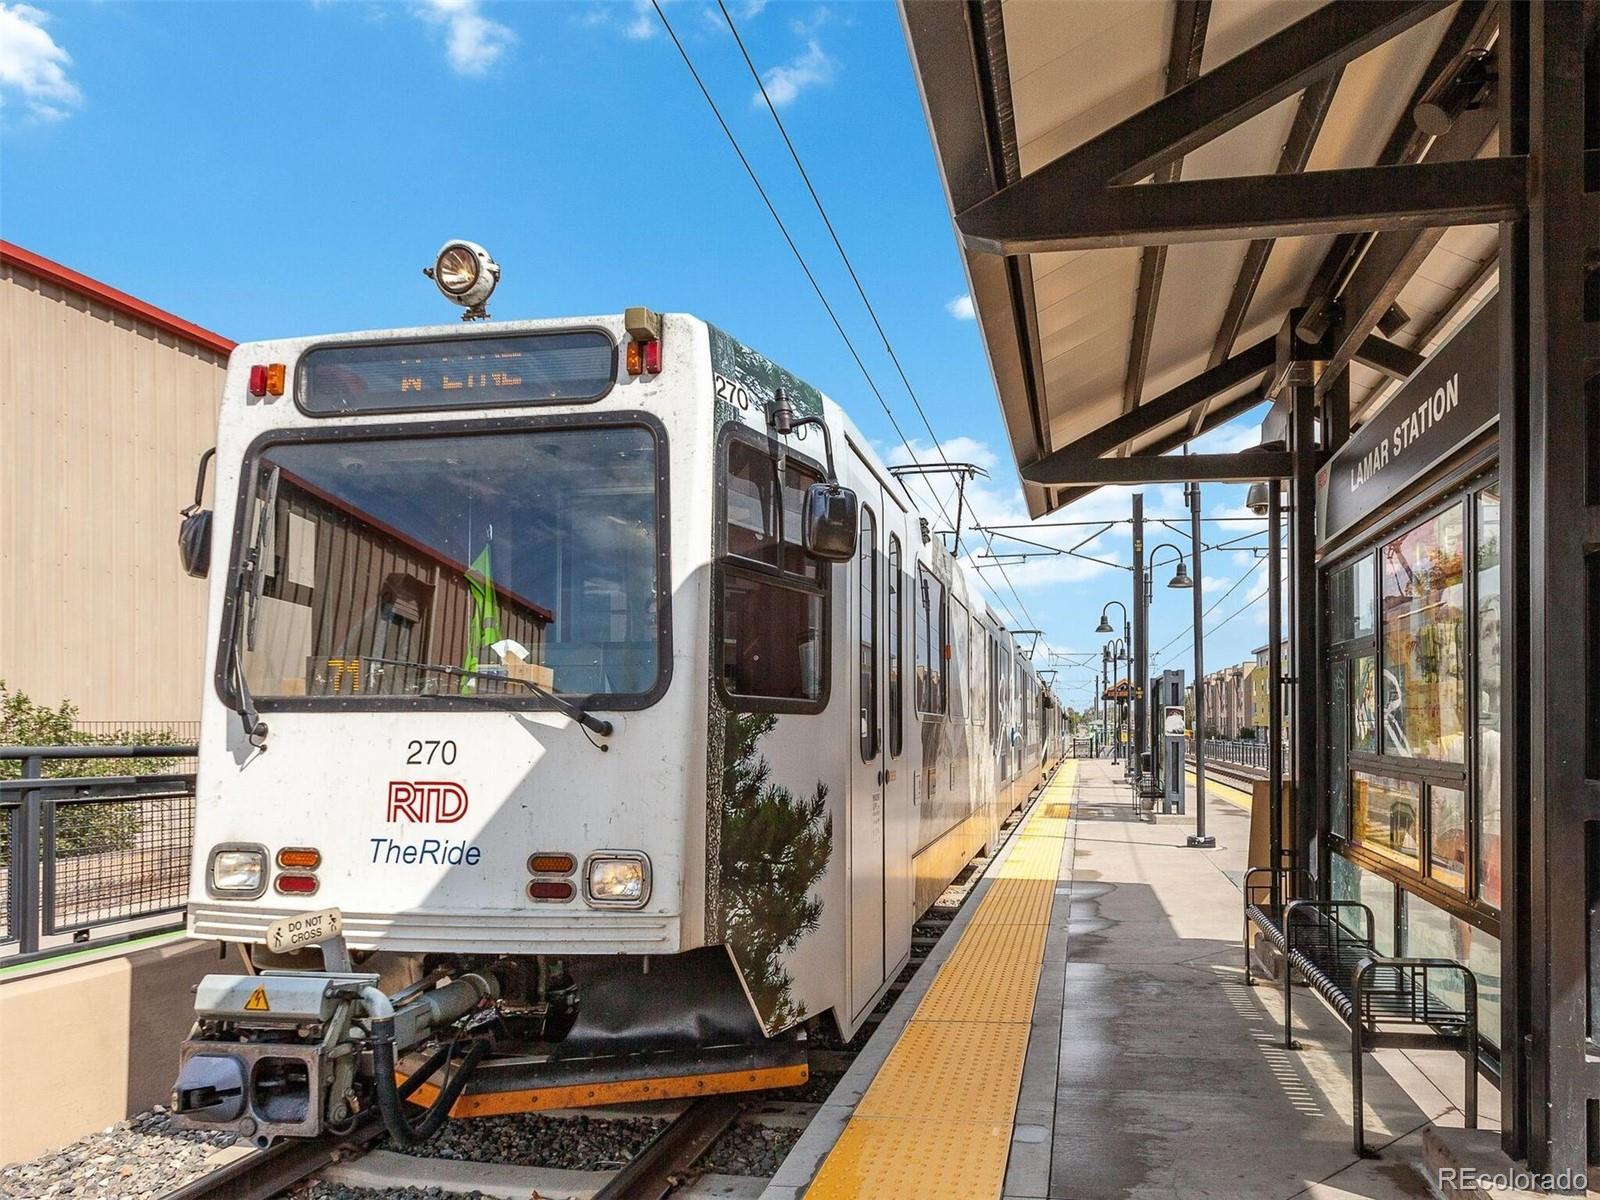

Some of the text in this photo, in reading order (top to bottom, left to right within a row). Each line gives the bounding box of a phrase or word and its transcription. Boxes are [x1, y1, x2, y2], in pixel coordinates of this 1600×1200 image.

[716, 375, 749, 411] 270
[1350, 373, 1459, 493] LAMAR STATION
[406, 740, 457, 765] 270
[386, 781, 469, 823] RTD
[370, 838, 481, 866] TheRide
[288, 915, 323, 932] DO NOT
[291, 927, 322, 944] CROSS
